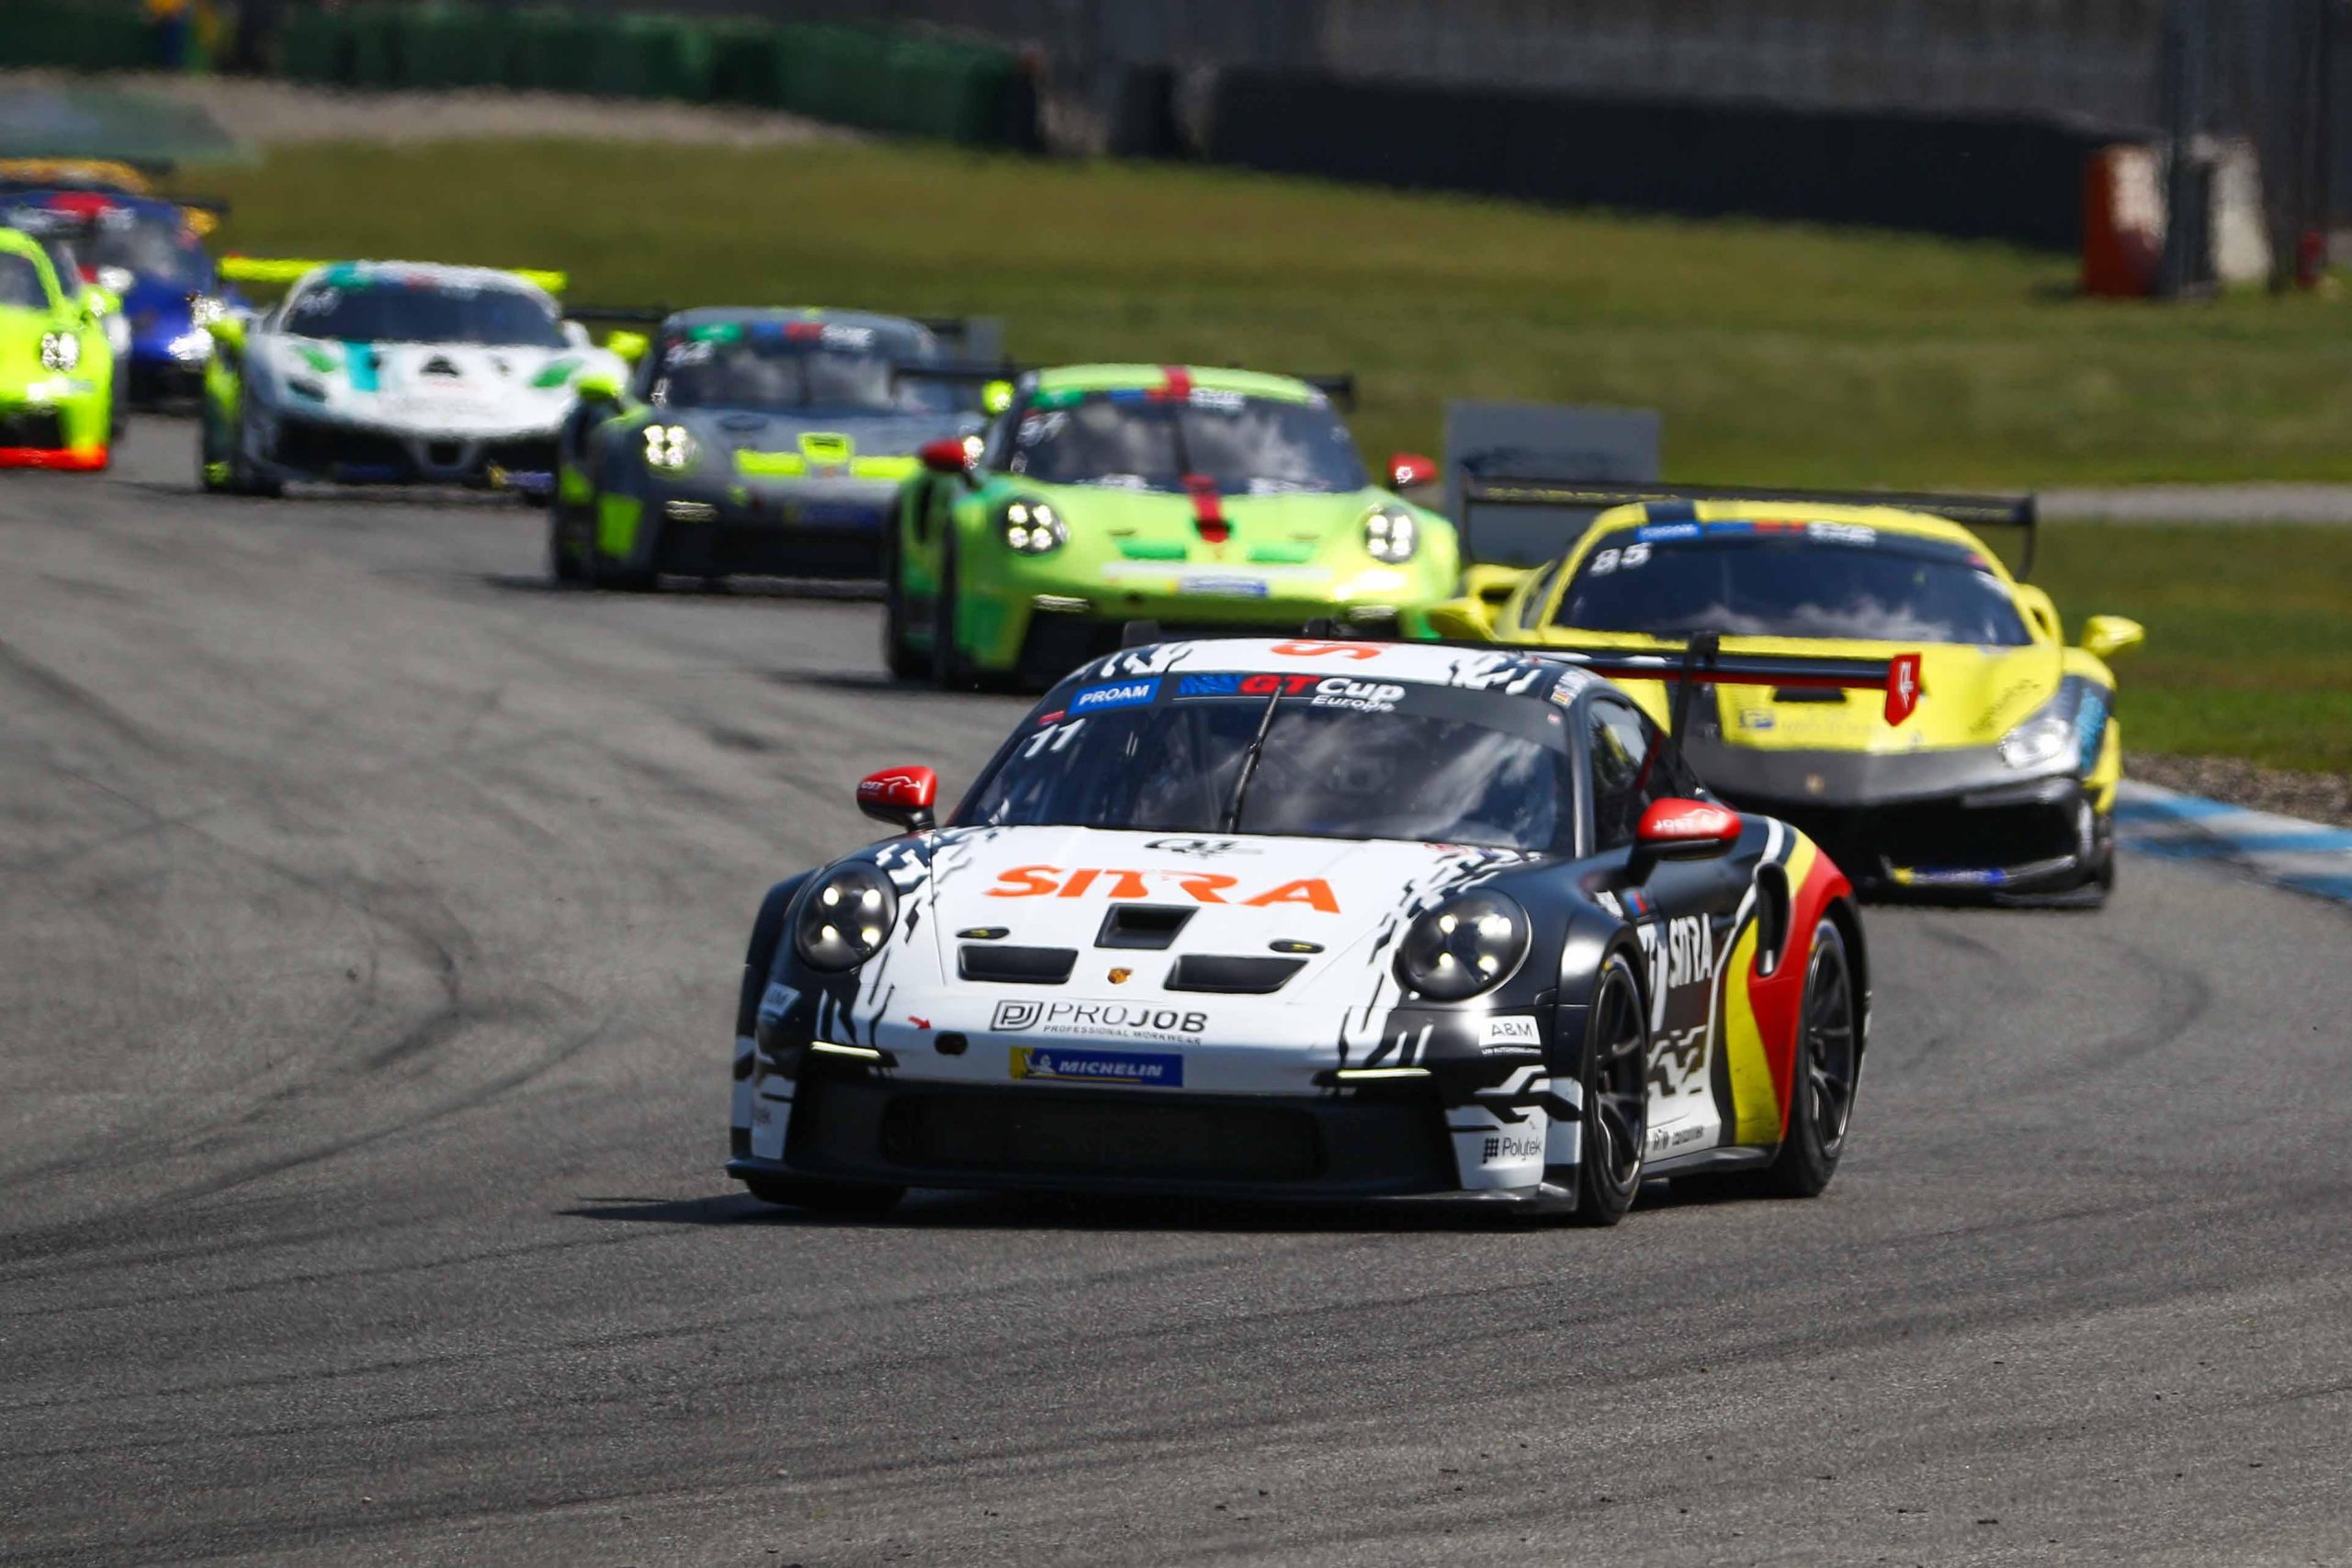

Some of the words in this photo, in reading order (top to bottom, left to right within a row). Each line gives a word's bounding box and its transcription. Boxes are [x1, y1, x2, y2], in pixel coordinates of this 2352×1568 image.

[1078, 684, 1150, 705] PROAM
[1239, 674, 1320, 695] GT
[1316, 677, 1406, 703] Cup
[1311, 694, 1396, 713] Europe
[1023, 717, 1087, 758] 11
[981, 864, 1341, 914] SITRA
[1668, 911, 1713, 989] SITRA
[1046, 1001, 1209, 1033] PROJOB
[1043, 1024, 1129, 1038] PROFESSIONAL
[1133, 1030, 1203, 1046] WORKWEAR
[1491, 1022, 1534, 1038] A&M
[1058, 1059, 1164, 1077] MICHELIN
[1501, 1137, 1543, 1161] Polytek
